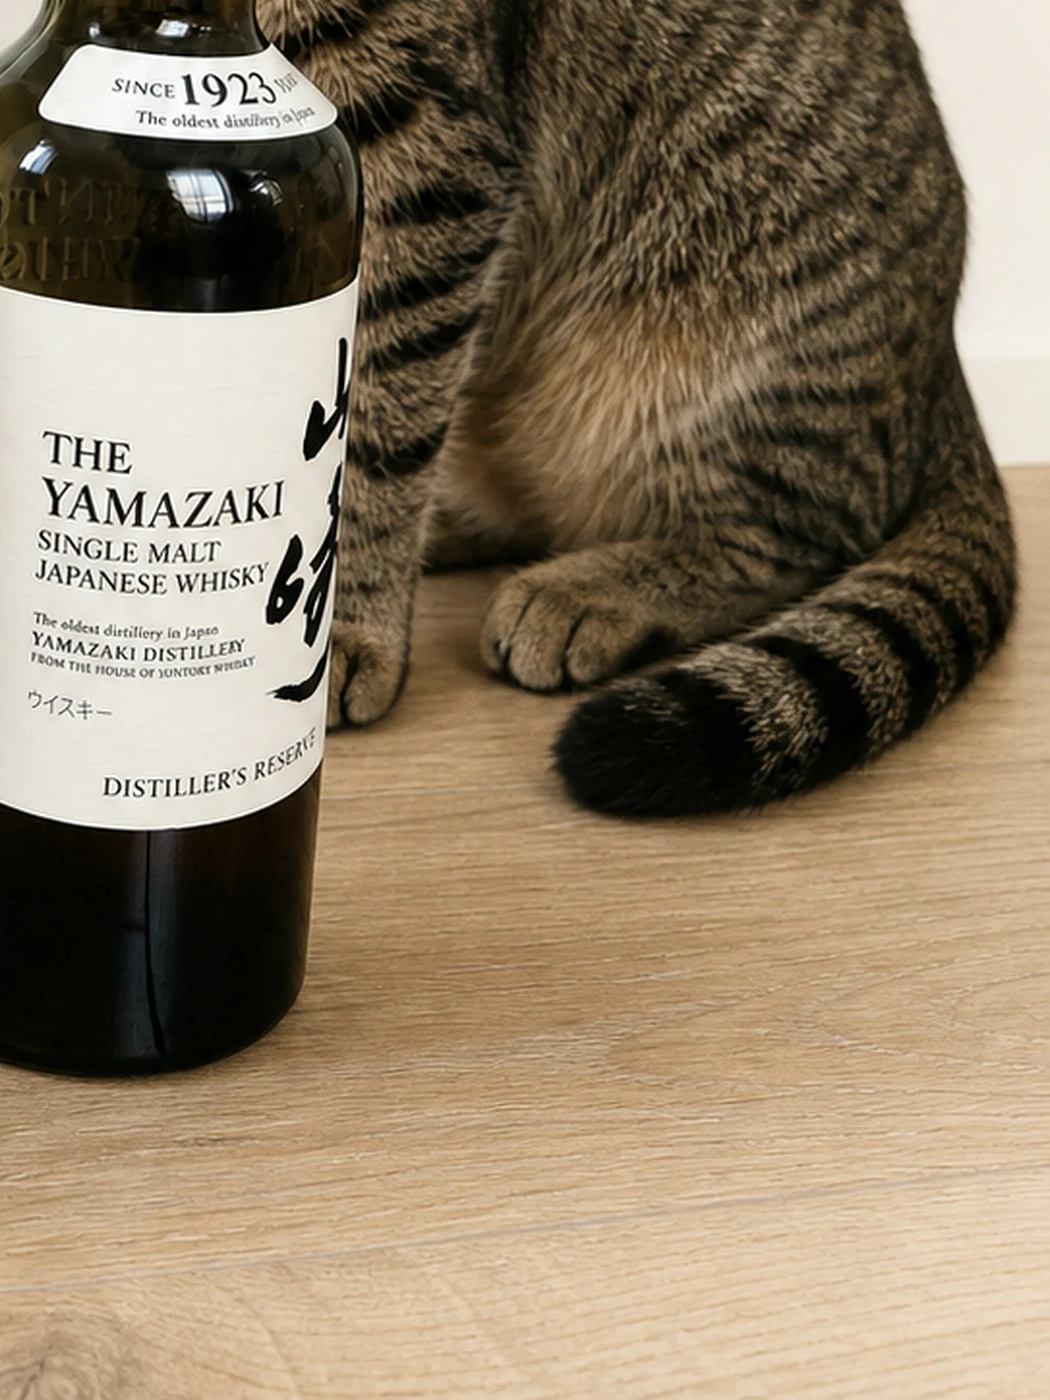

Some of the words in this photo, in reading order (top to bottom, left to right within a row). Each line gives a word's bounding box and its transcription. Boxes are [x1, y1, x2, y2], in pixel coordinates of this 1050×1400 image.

[111, 78, 175, 99] SINCE
[181, 71, 277, 108] 1923
[135, 110, 167, 126] The
[171, 113, 220, 129] oldest
[42, 430, 133, 475] THE
[40, 476, 285, 529] YAMAZAKI
[37, 529, 139, 564] SINGLE
[148, 540, 222, 564] MALT
[35, 559, 168, 595] JAPANESE
[175, 561, 271, 593] WHISKY
[33, 611, 58, 629] The
[60, 618, 100, 636] oldest
[167, 627, 181, 639] in
[31, 652, 65, 669] FROM
[32, 631, 136, 661] YAMAZAKI
[27, 690, 113, 721] ウイスキー
[103, 766, 247, 798] DISTILLER’S
